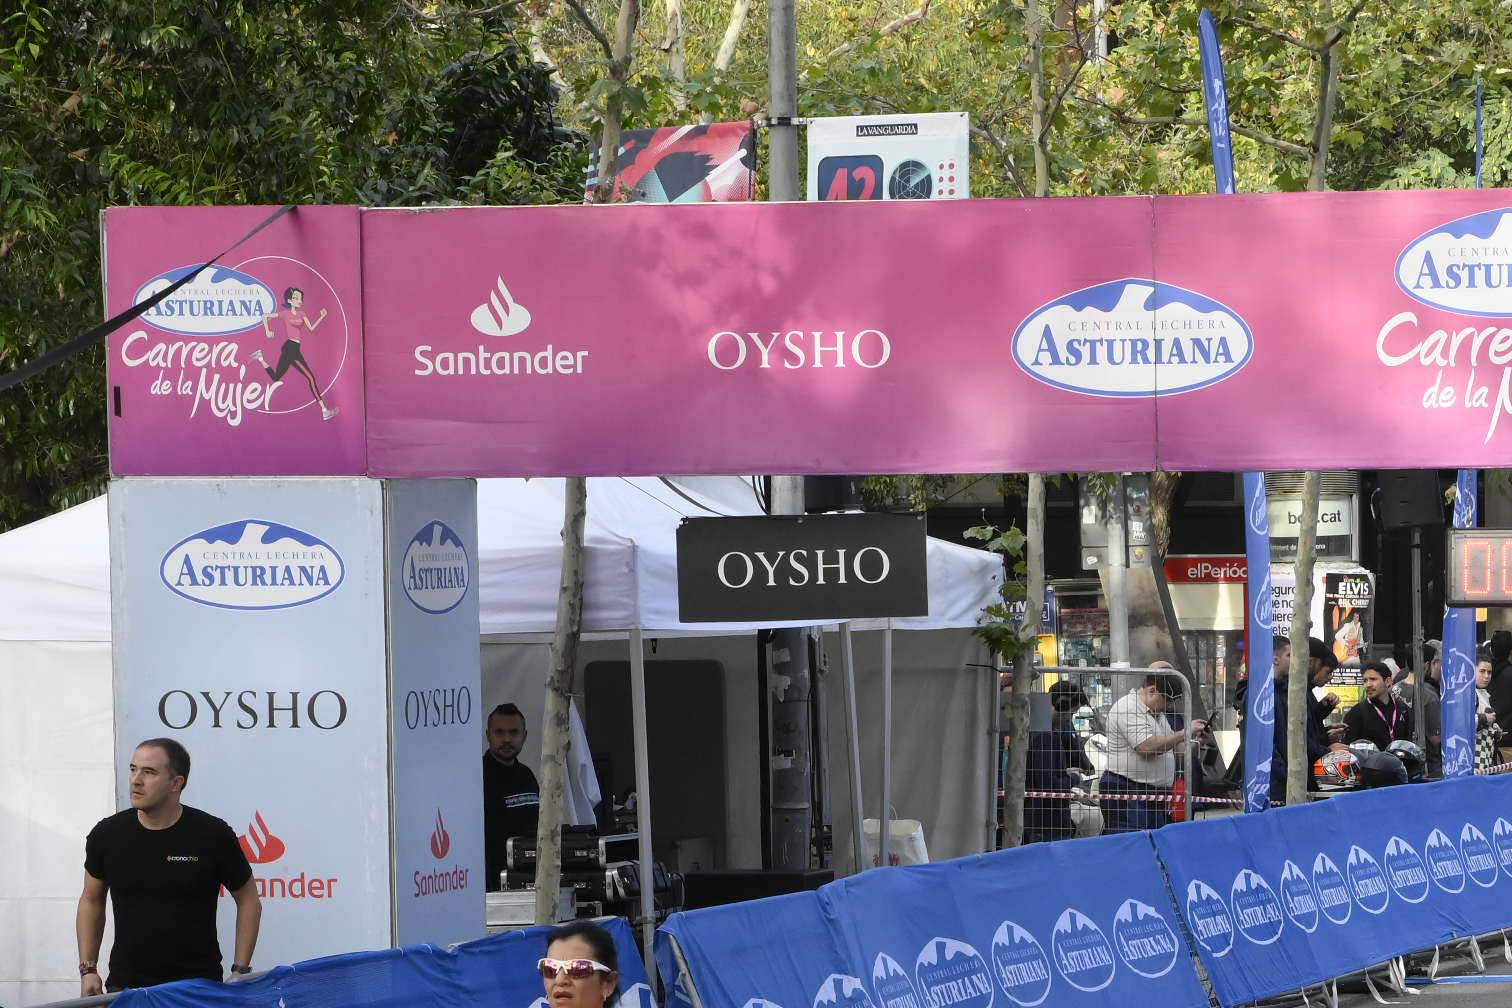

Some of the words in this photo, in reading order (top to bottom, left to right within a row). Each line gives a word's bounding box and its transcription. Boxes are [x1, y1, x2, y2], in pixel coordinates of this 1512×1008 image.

[1067, 320, 1143, 331] CENTRAL
[1150, 319, 1227, 330] LECHERA
[121, 331, 240, 367] Carrera
[415, 345, 589, 376] Santander
[707, 329, 891, 369] OYSHO
[1031, 323, 1234, 366] ASTURIANA
[150, 370, 172, 395] de
[177, 370, 193, 395] la
[189, 364, 284, 426] Mujer
[1422, 367, 1457, 409] de
[1463, 365, 1489, 409] la
[1288, 510, 1342, 524] b.cat
[175, 553, 331, 587] ASTURIANA
[202, 551, 261, 560] CENTRAL
[266, 551, 325, 560] LECHERA
[717, 546, 890, 588] OYSHO
[407, 556, 466, 590] ASTURIANA
[1339, 582, 1369, 595] ELVIS
[158, 689, 348, 730] OYSHO
[405, 686, 472, 729] OYSHO
[219, 872, 338, 898] ander
[413, 866, 469, 897] Santander
[997, 958, 1049, 988] ASTURIANA
[1058, 944, 1113, 974] ASTURIANA
